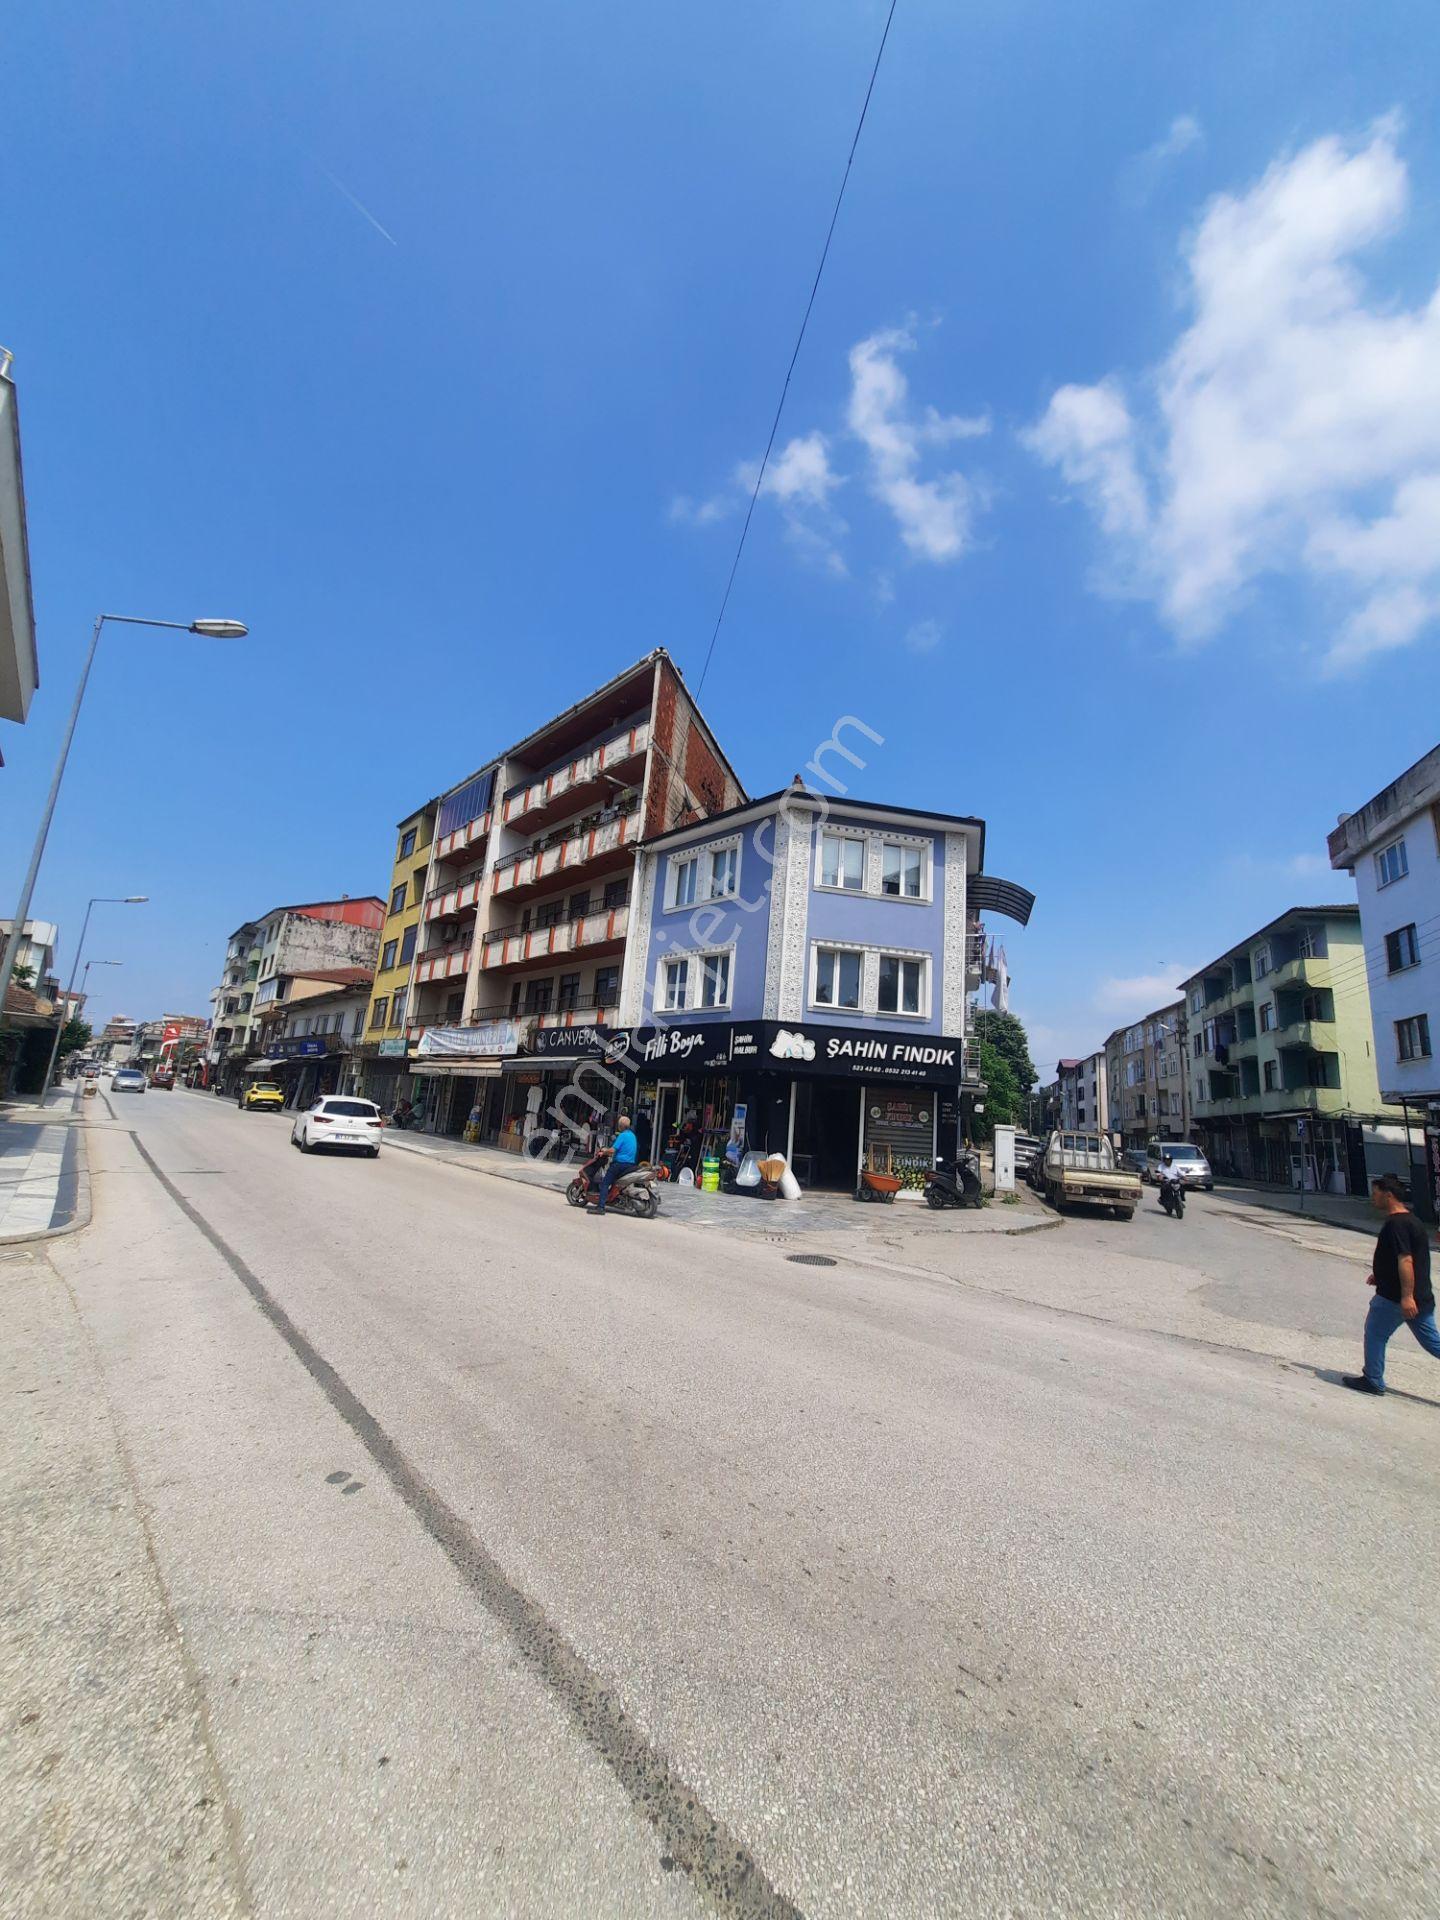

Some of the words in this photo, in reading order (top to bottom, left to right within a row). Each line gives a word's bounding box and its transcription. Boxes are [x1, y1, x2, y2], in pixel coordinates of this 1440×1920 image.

[549, 1030, 599, 1047] CANVERA
[644, 1033, 669, 1062] Filli
[669, 1030, 705, 1058] Boya
[826, 1038, 888, 1059] ŞAHİN
[892, 1044, 956, 1066] FINDIK
